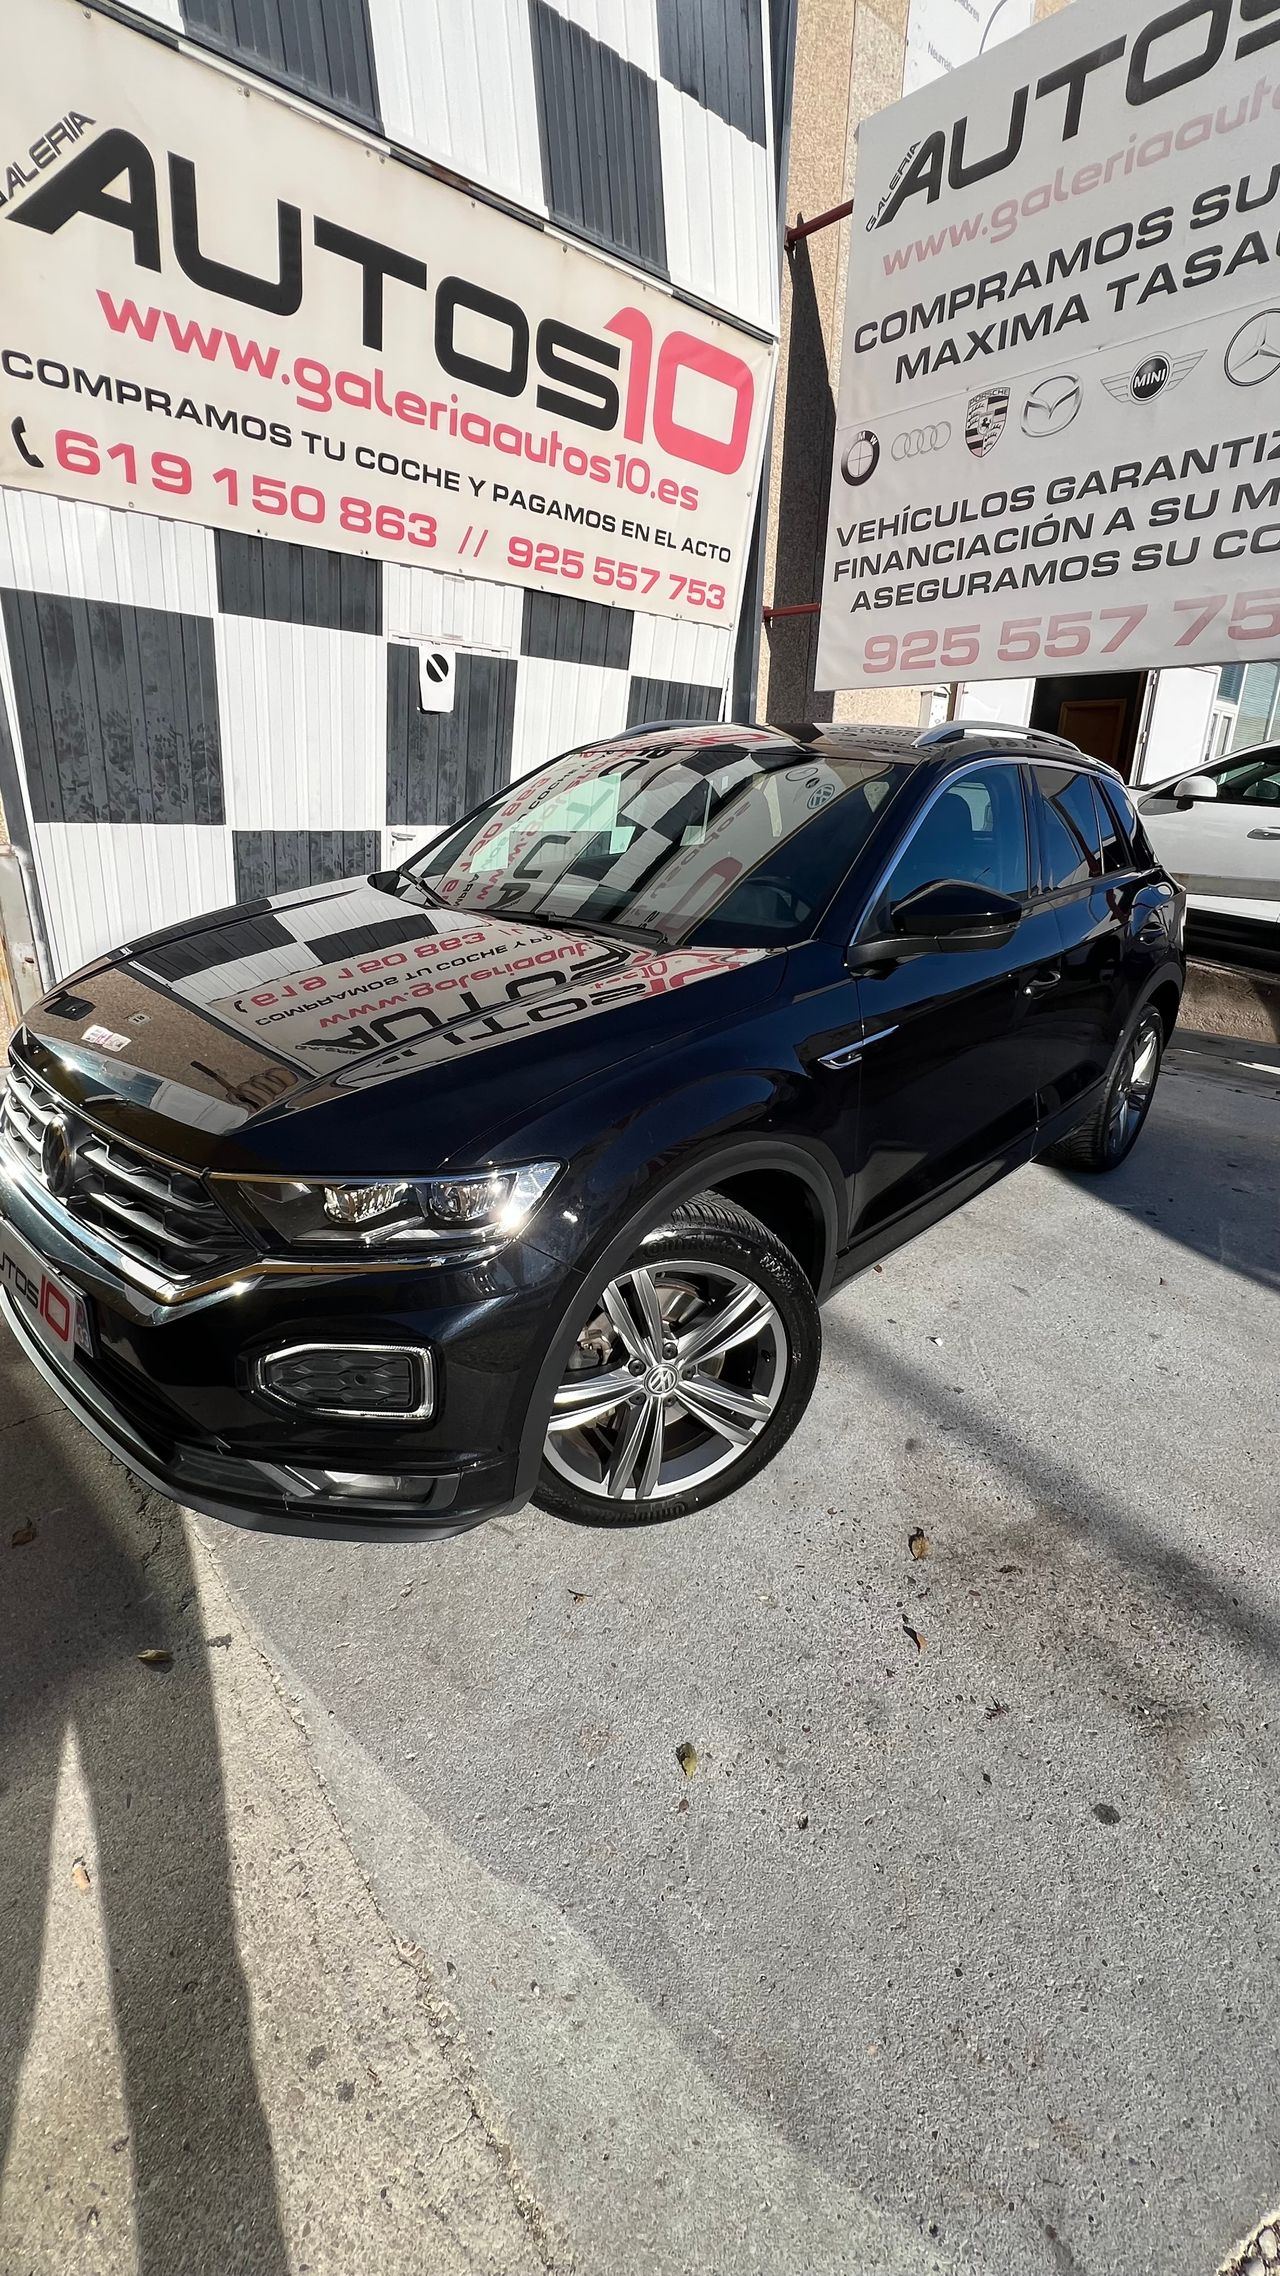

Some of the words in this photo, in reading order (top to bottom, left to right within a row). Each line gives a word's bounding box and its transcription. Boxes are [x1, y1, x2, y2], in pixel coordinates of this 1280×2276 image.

[866, 141, 921, 232] GALERIA
[5, 128, 754, 475] AUTOS10
[854, 206, 1174, 353] COMPRAMOS
[1190, 163, 1280, 229] SU
[896, 293, 1091, 384] MAXIMA
[1107, 230, 1280, 312] TASA
[96, 289, 699, 511] www.galeriaautos10.es
[1133, 368, 1167, 389] MINI
[1, 350, 292, 447] COMPRAMOS
[301, 431, 345, 461] TU
[356, 446, 460, 491] COCHE
[468, 476, 486, 497] Y
[493, 483, 616, 532] PAGAMOS
[621, 521, 650, 542] EN
[655, 530, 677, 549] EL
[681, 538, 731, 563] ACTO
[836, 485, 1035, 547] VEHÍCULOS
[55, 429, 192, 495] 619
[212, 467, 326, 523] 150
[340, 497, 437, 548] 863
[507, 536, 585, 579] 925
[593, 556, 660, 594] 557
[669, 574, 726, 610] 753
[834, 513, 1094, 582] FINANCIACIÓN
[1103, 506, 1135, 535] A
[1149, 488, 1220, 527] SU
[850, 550, 1120, 613] ASEGURAMOS
[1132, 536, 1200, 572] SU
[863, 624, 981, 674] 925
[997, 604, 1148, 662] 557
[1174, 588, 1280, 647] 75
